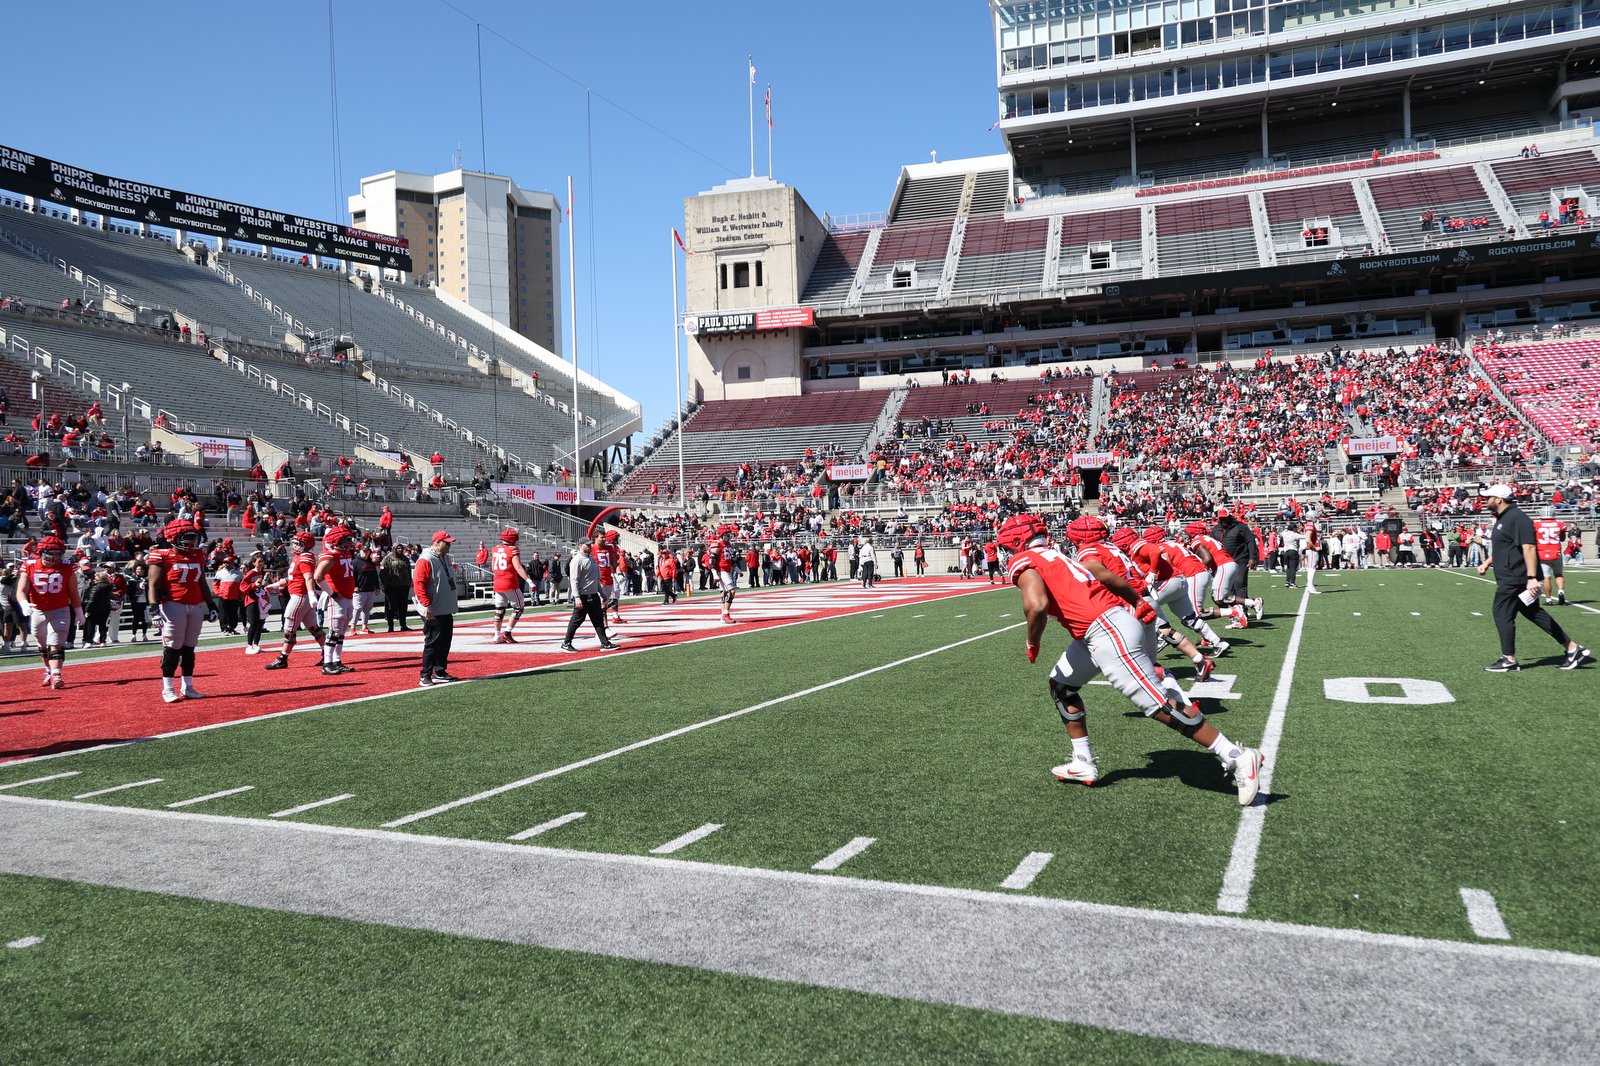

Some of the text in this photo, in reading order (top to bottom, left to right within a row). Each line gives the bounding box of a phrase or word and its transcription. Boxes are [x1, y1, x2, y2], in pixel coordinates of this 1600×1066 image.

[0, 158, 26, 174] KER
[50, 162, 94, 182] PHIPPS
[53, 173, 149, 204] O'SHAUGHNESSY
[108, 179, 171, 199] McCORKLE
[75, 195, 136, 215] ROCKYBOOTS.COM
[175, 202, 219, 218] NOURSE
[185, 195, 286, 223] HUNTINGTON BANK
[169, 216, 227, 232] ROCKYBOOTS.COM
[240, 215, 272, 229] PRIOR
[294, 217, 339, 233] WEBSTER
[711, 215, 729, 224] Hugh
[738, 212, 760, 221] Nesbitt
[283, 223, 327, 239] RITE RUG
[696, 226, 720, 235] William
[730, 223, 760, 231] Westwater
[762, 219, 784, 228] Family
[256, 232, 308, 248] ROCKYBOOTS.COM
[332, 233, 368, 248] SAVAGE
[716, 232, 764, 243] Stadium Center
[334, 247, 380, 262] ROCKYBOOTS.COM
[374, 242, 410, 256] NETJETS
[1488, 239, 1576, 257] ROCKYBOOTS.COM
[1360, 254, 1440, 270] ROCKYBOOTS.COM
[699, 316, 721, 328] PAUL
[722, 314, 753, 327] BROWN
[1354, 440, 1391, 452] meijer
[1077, 454, 1109, 466] meijer
[835, 466, 864, 478] meijer
[556, 488, 578, 504] meije
[1537, 527, 1561, 544] 35
[493, 552, 507, 570] 76
[597, 552, 610, 567] 51
[173, 563, 202, 583] 77
[33, 573, 64, 593] 58
